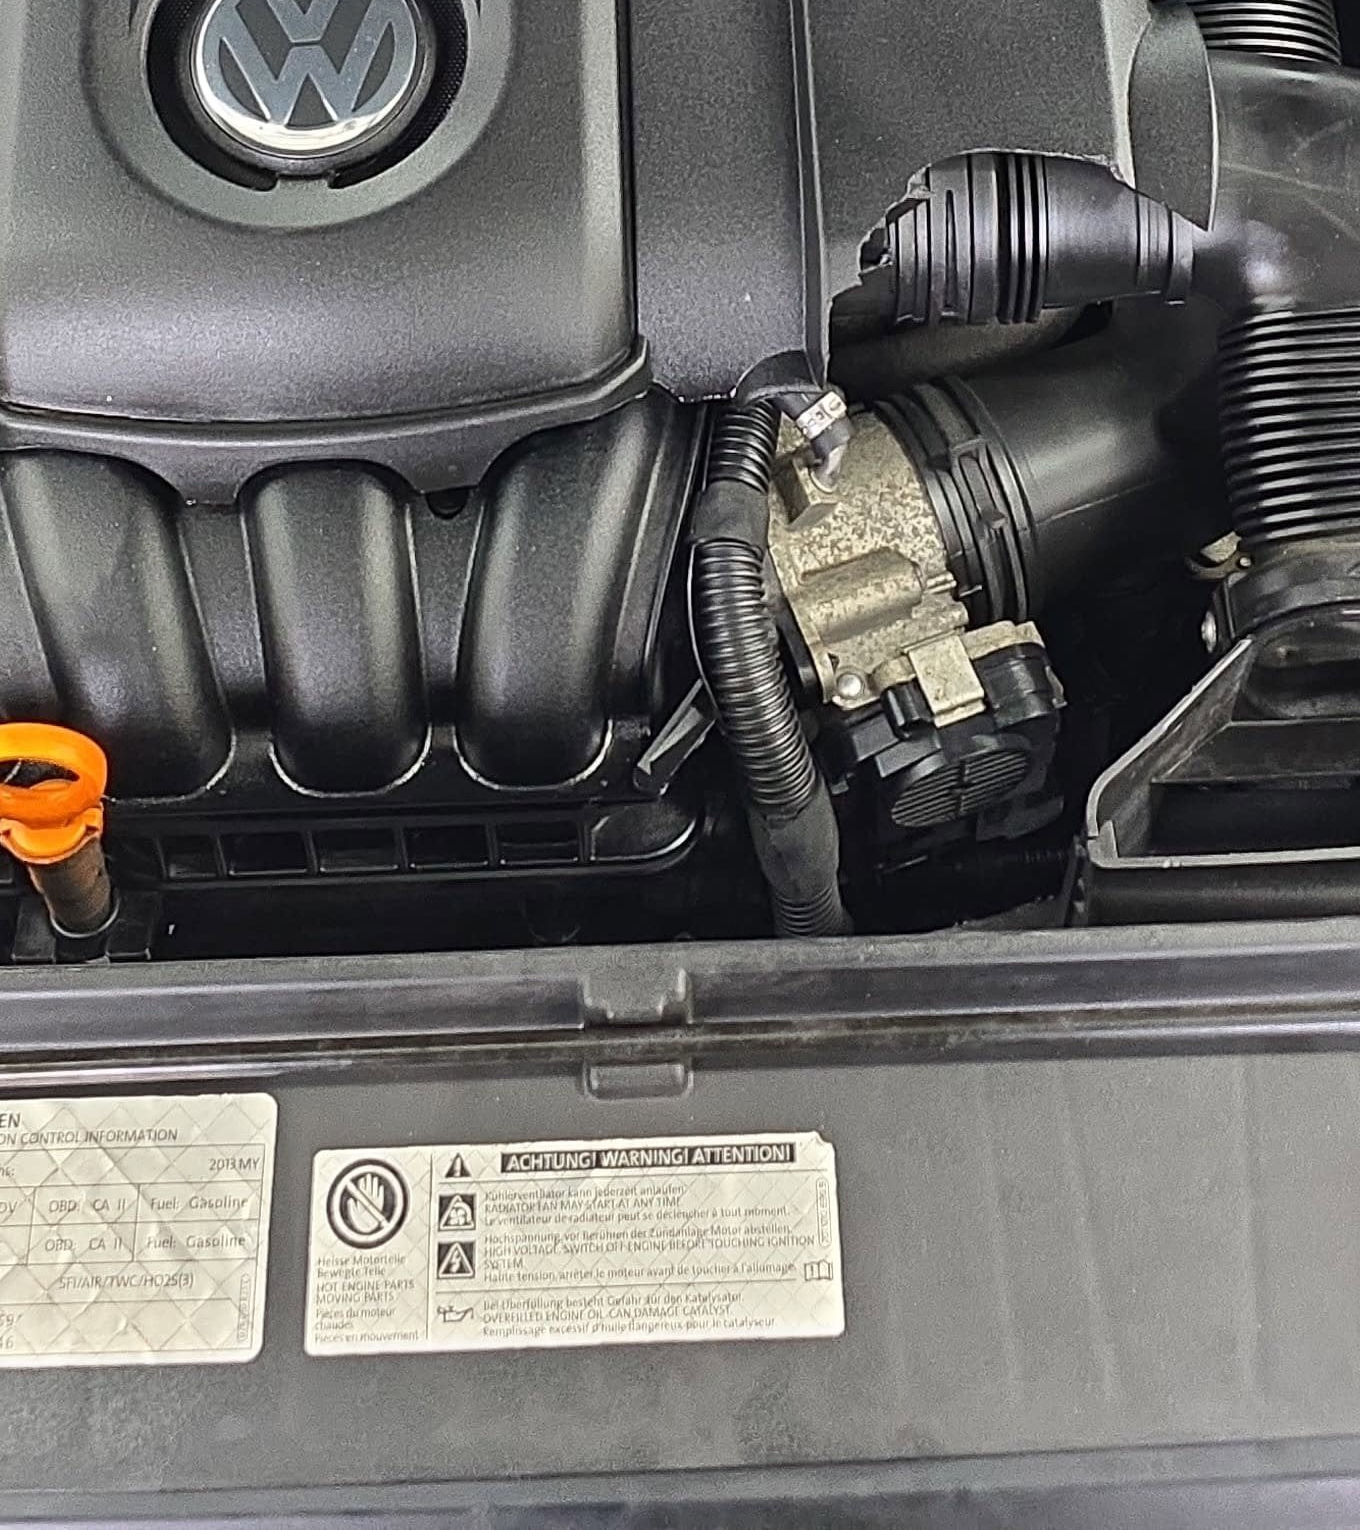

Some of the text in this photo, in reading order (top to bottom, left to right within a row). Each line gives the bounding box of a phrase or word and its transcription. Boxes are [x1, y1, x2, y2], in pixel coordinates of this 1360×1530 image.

[20, 1130, 81, 1146] CONTROL
[84, 1128, 179, 1144] INFORMATION
[209, 1157, 260, 1171] 2013 MY
[506, 1144, 791, 1171] ACHTUNG! WARNING! ATTENTION!
[92, 1198, 110, 1211] CA
[150, 1195, 249, 1210] Fuel: Gasoline
[89, 1237, 106, 1251] CA
[147, 1234, 246, 1250] Fuel: Gasoline
